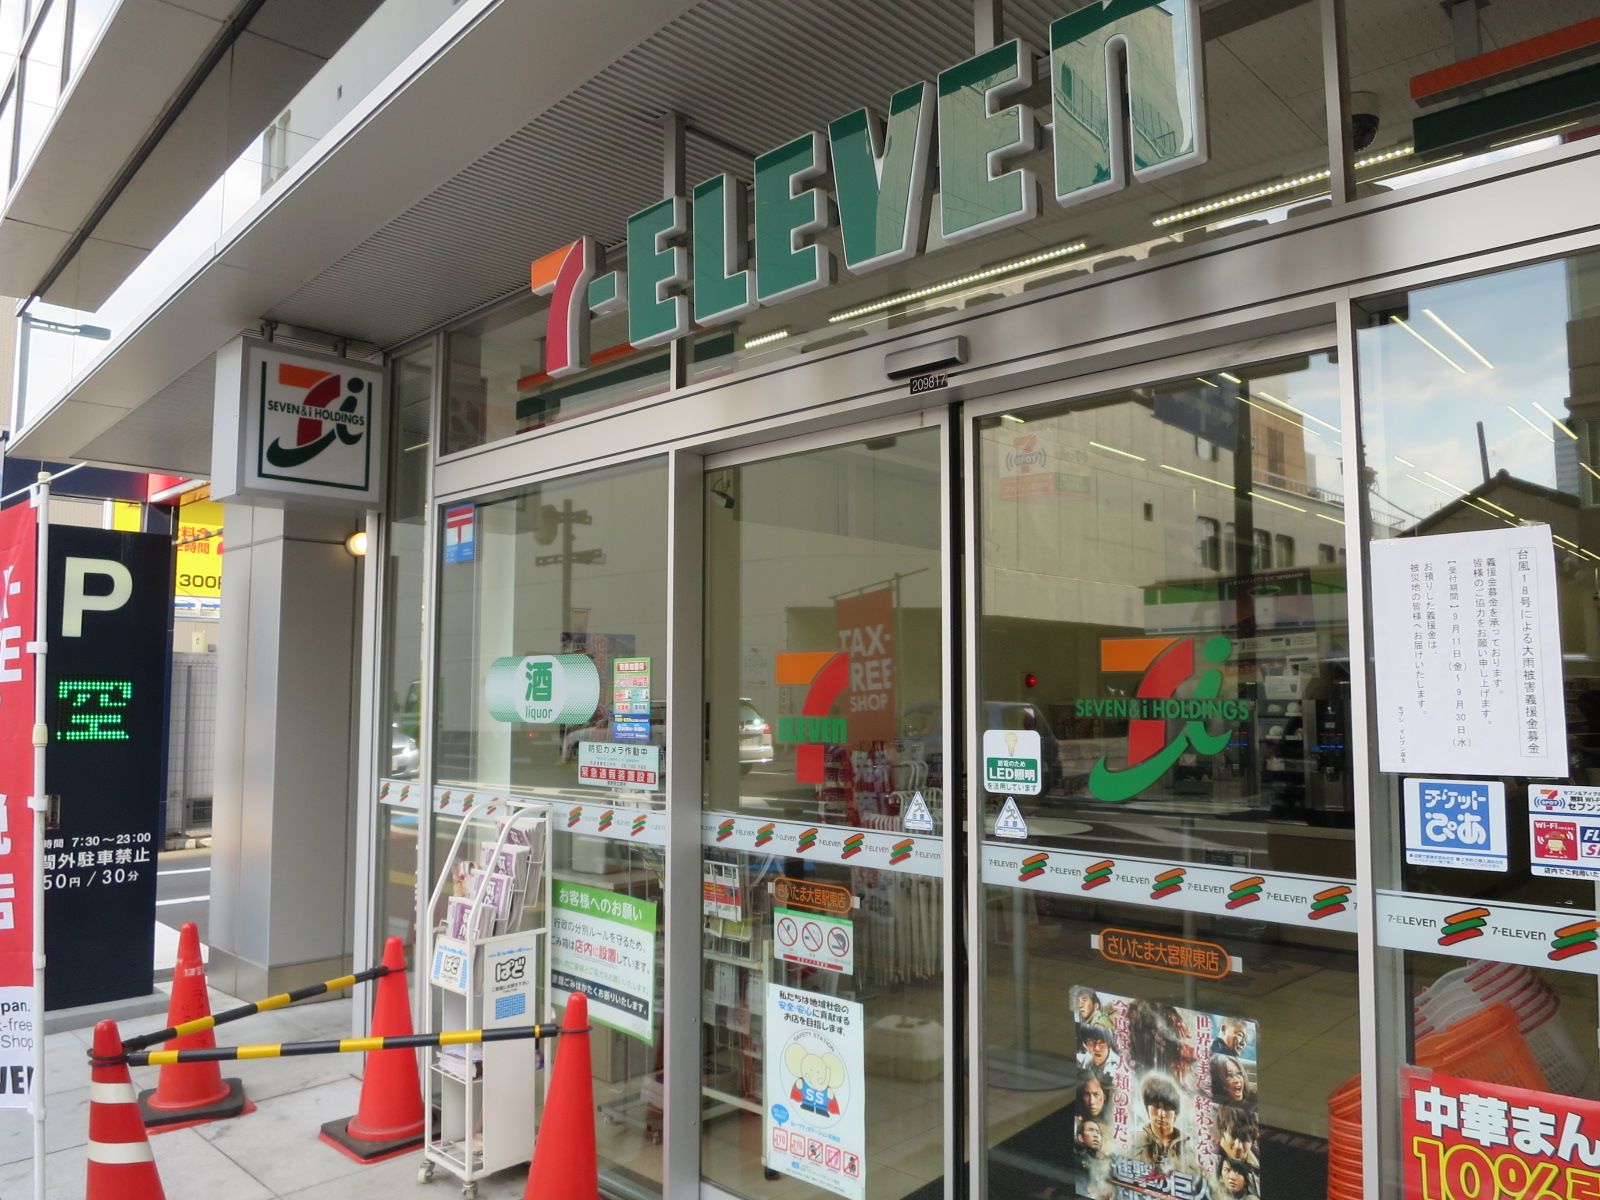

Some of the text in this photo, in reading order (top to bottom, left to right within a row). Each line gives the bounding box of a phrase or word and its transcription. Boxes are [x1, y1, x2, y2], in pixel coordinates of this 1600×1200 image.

[912, 374, 946, 392] 209817
[315, 407, 365, 426] HOLDINGS
[178, 526, 210, 541] 料金
[62, 557, 133, 638] P
[1517, 549, 1540, 754] 台風18号による大雨被害義援金募金
[525, 661, 553, 702] 酒
[851, 658, 893, 692] REE
[57, 681, 133, 742] 空
[525, 705, 553, 720] liquor
[851, 693, 888, 713] SHOP
[1153, 699, 1250, 721] HOLDINGS
[588, 744, 648, 756] 防犯カメラ作動中
[989, 767, 1035, 781] LED照明
[1424, 789, 1487, 810] チケット
[1425, 812, 1487, 845] ぴあ
[559, 888, 642, 921] お客様へのお願い
[1107, 935, 1220, 972] さいたま大宮駅東店
[496, 956, 526, 982] ぱど
[1414, 1086, 1600, 1167] 中華まん
